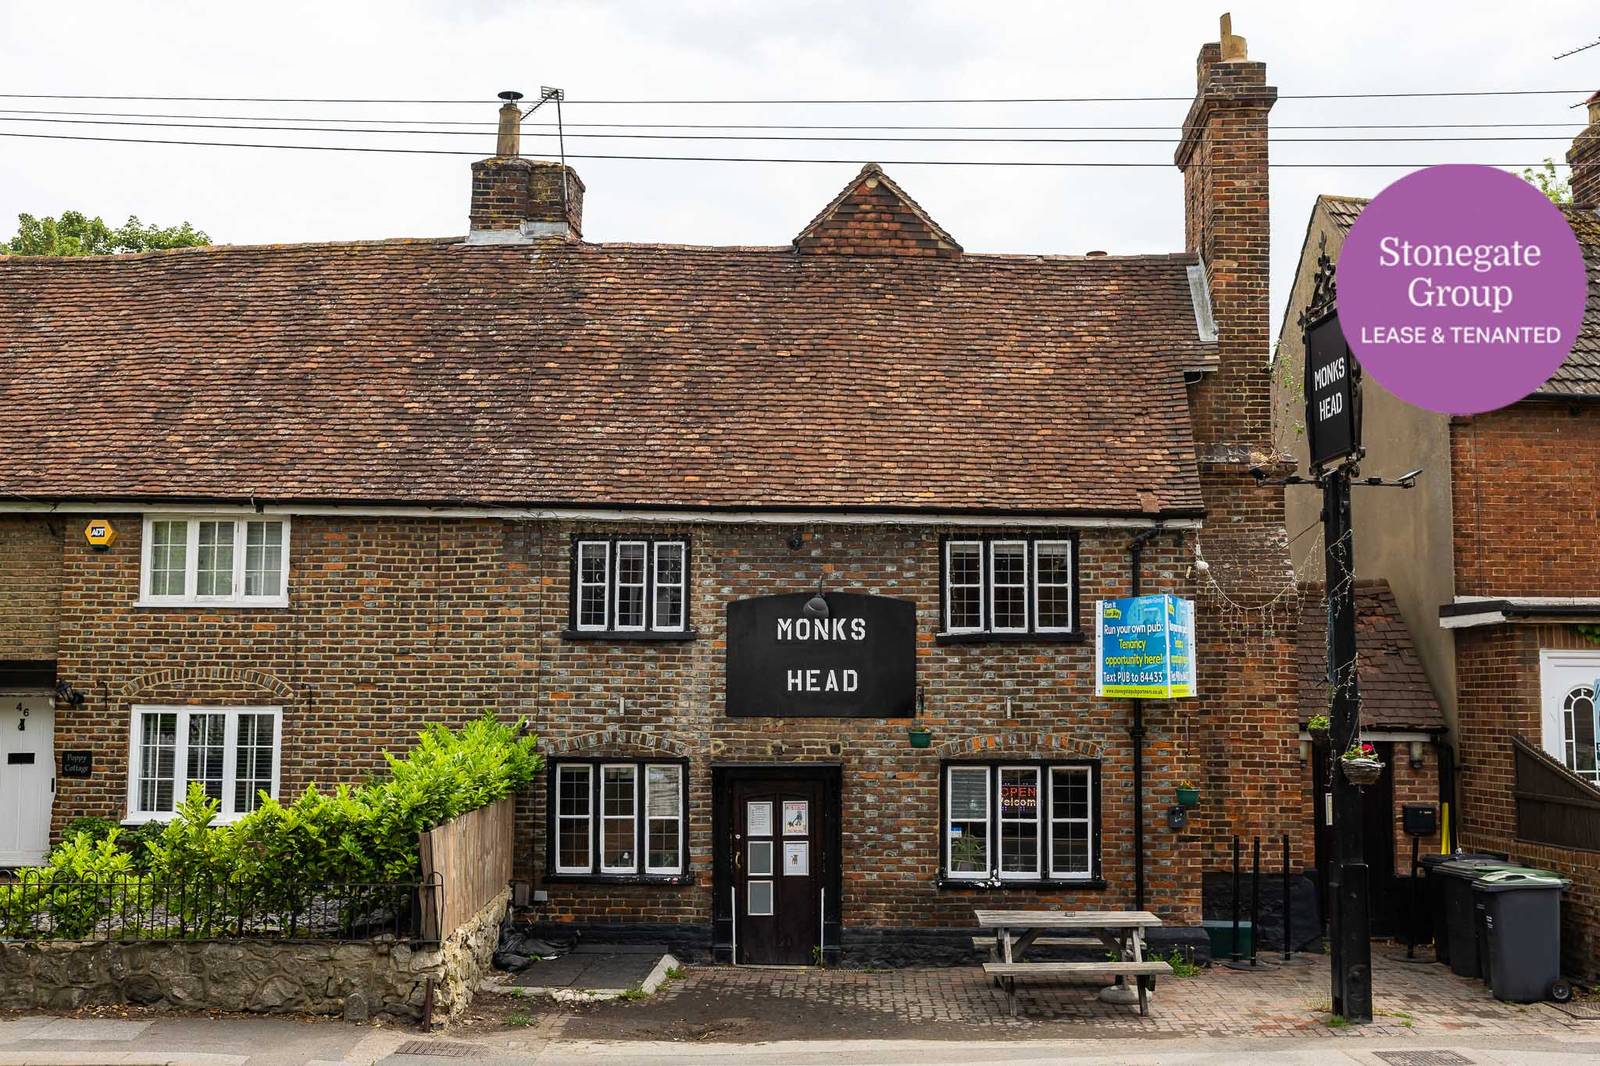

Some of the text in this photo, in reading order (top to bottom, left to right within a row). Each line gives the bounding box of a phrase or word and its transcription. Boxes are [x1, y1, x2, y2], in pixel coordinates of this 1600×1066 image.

[1314, 356, 1346, 392] MONKS
[1319, 391, 1343, 422] HEAD
[91, 527, 105, 537] ADT
[777, 618, 866, 641] MONKS
[1104, 624, 1116, 635] Run
[1116, 625, 1131, 637] your
[1131, 624, 1146, 634] own
[1147, 620, 1164, 636] pub:
[1119, 639, 1146, 651] Tenancy
[1105, 654, 1143, 667] opportunity
[1144, 653, 1162, 664] here!
[787, 669, 858, 692] HEAD
[1103, 672, 1117, 682] Text
[1117, 671, 1130, 683] PUB
[1131, 672, 1139, 683] to
[1140, 671, 1163, 683] 84433
[1002, 787, 1036, 797] OPEN
